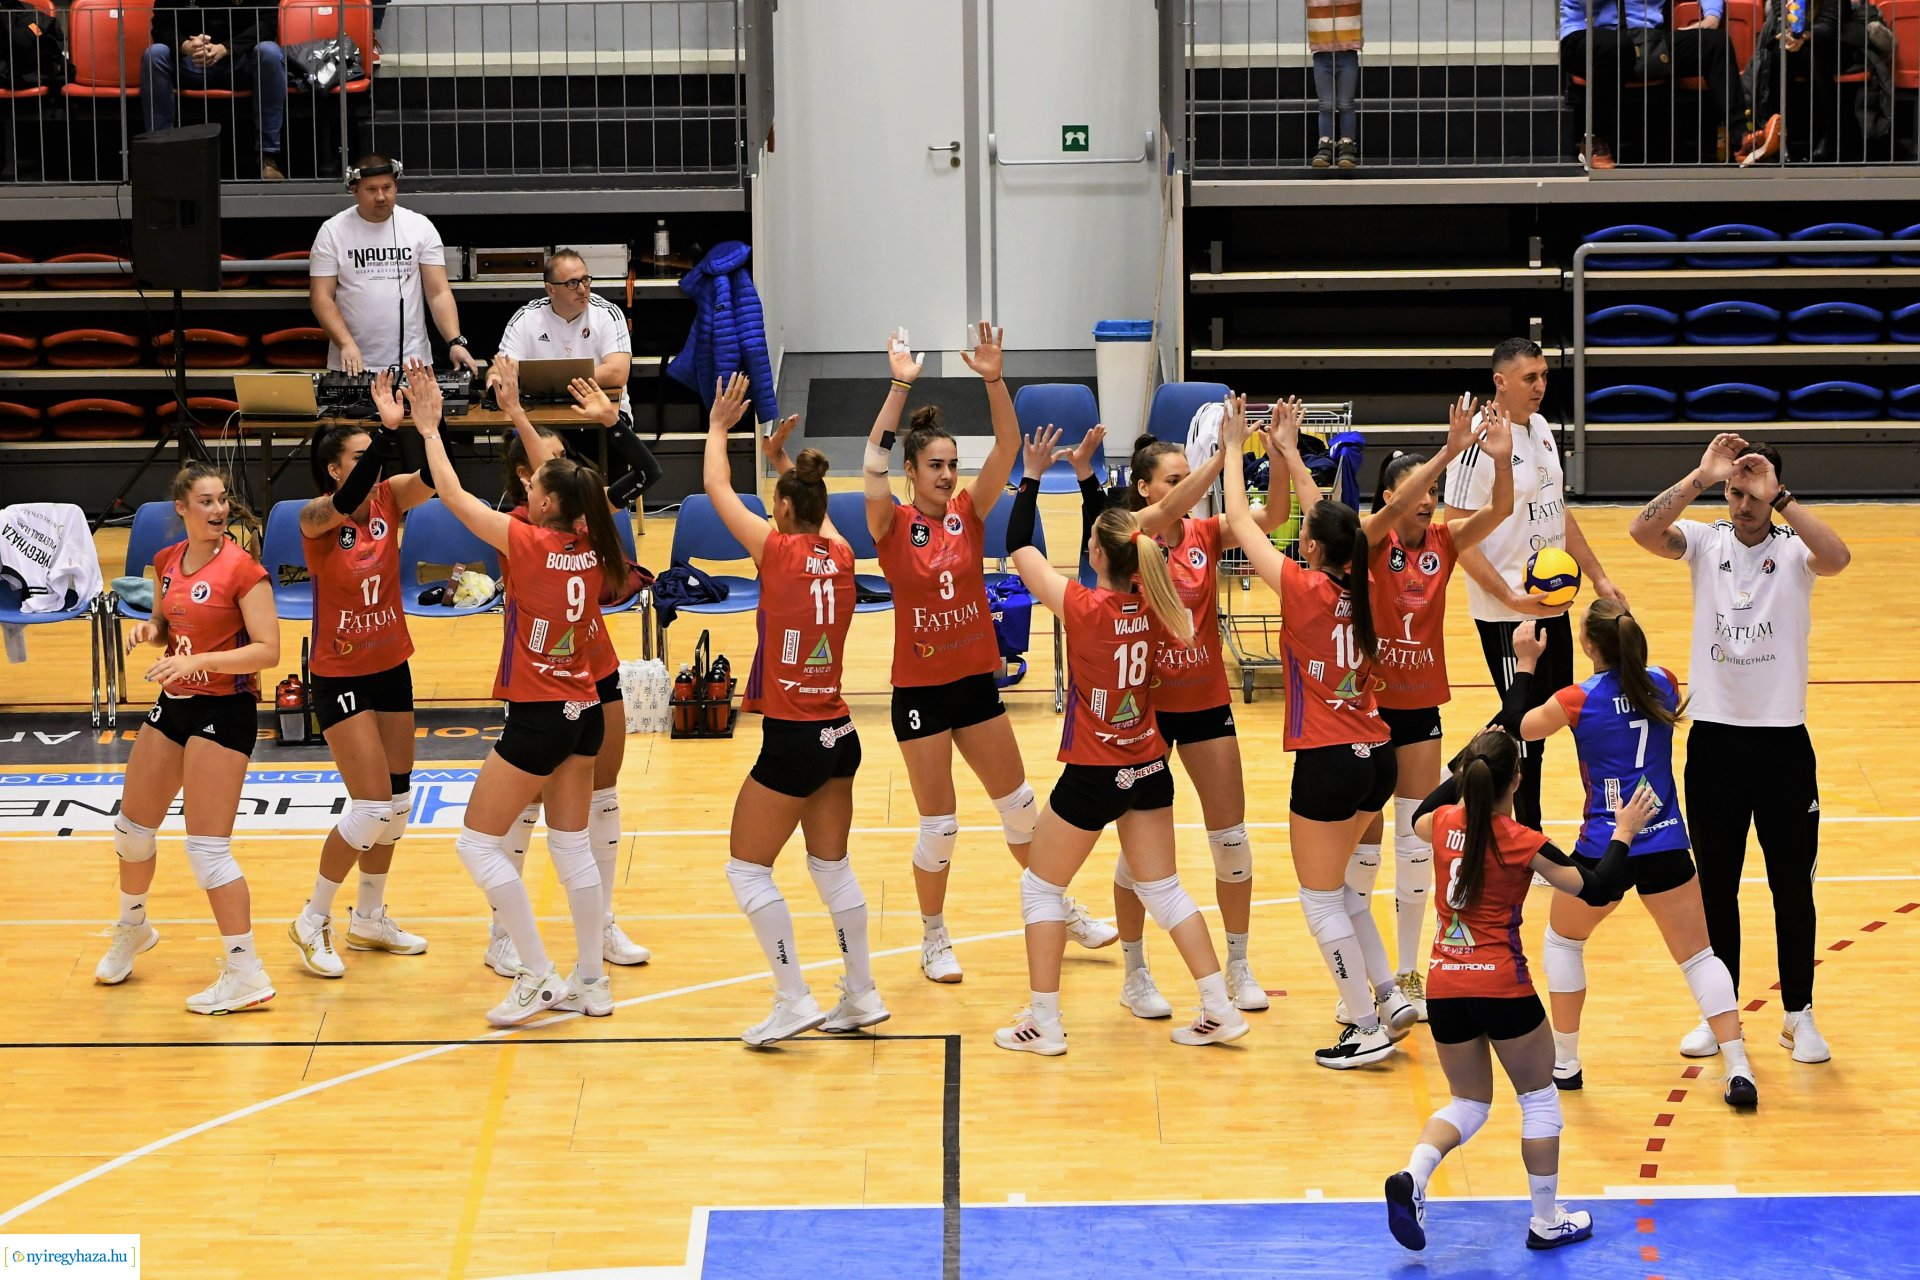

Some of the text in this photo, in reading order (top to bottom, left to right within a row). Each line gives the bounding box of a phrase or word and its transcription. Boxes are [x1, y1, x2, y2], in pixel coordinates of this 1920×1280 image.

[354, 247, 412, 268] NAUTIC
[361, 575, 381, 606] 17
[566, 576, 586, 622] 9
[939, 570, 955, 600] 3
[810, 578, 835, 625] 11
[912, 601, 979, 628] FATUM
[533, 621, 544, 650] STRABAG
[1114, 615, 1150, 635] VAJDA
[1715, 611, 1773, 640] FATUM
[787, 631, 796, 662] STRABAG
[1331, 624, 1364, 670] 10
[1376, 637, 1434, 665] FATUM
[1113, 640, 1149, 690] 18
[337, 691, 357, 714] 17
[908, 709, 921, 730] 3
[1629, 719, 1649, 769] 7
[1442, 963, 1496, 971] BESTRONG
